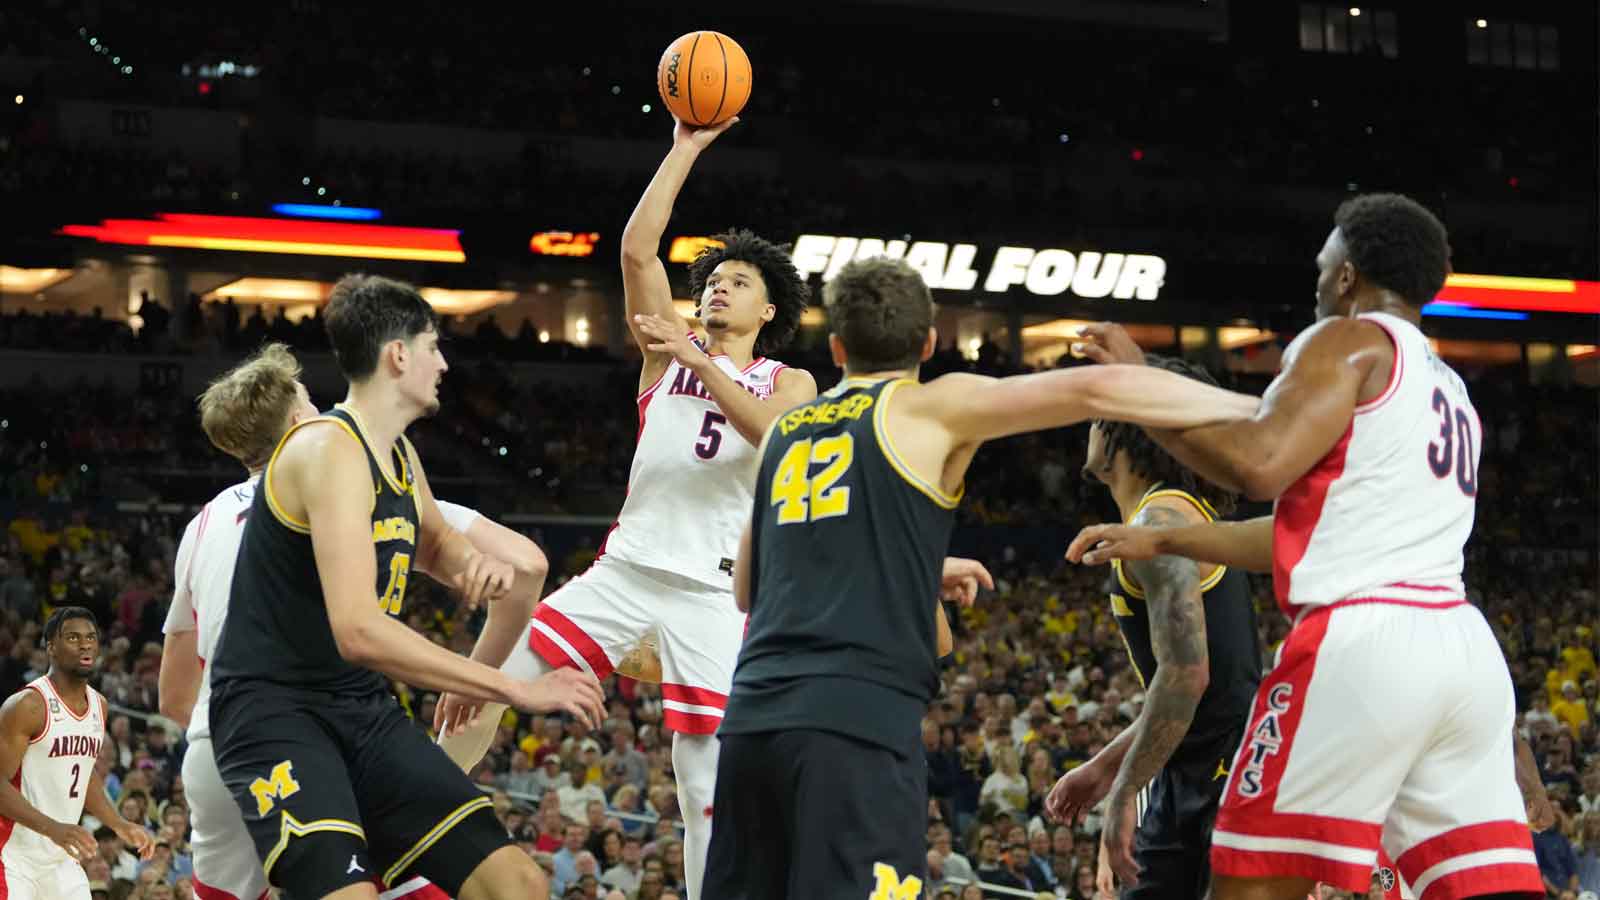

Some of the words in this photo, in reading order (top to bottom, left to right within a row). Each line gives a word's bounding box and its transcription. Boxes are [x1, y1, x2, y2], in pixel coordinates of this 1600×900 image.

[667, 52, 681, 98] NCAA
[984, 246, 1166, 300] FOUR
[694, 410, 727, 460] 5
[1427, 386, 1476, 497] 30
[770, 432, 854, 525] 42
[1238, 683, 1292, 798] CATS
[69, 763, 80, 799] 2
[249, 760, 301, 818] M
